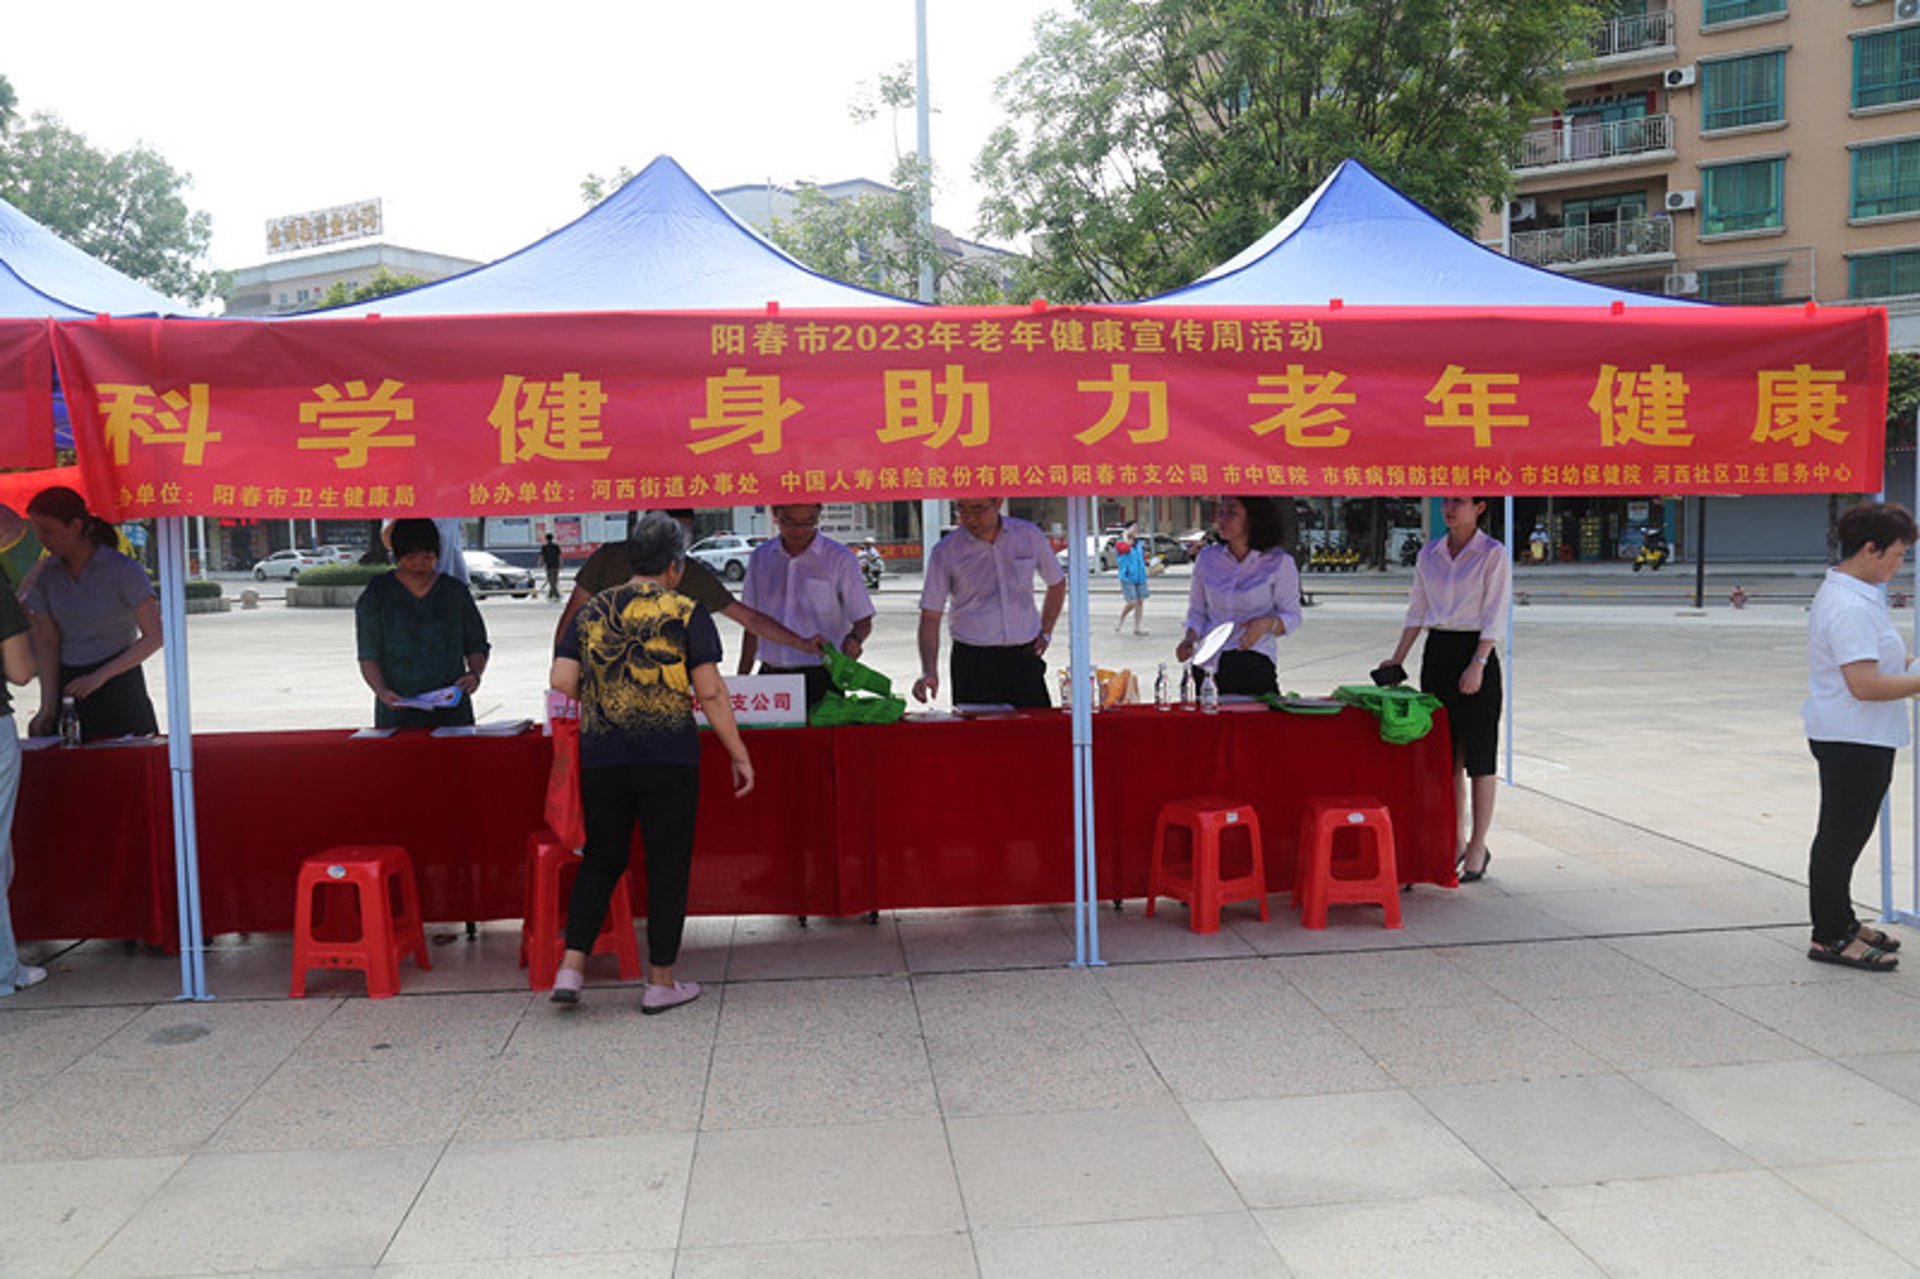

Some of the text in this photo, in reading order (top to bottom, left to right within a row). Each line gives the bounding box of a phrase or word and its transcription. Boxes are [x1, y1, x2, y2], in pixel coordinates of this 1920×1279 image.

[711, 319, 1324, 356] 阳春市2023年老年健康宣传周活动
[781, 463, 1208, 493] 中国人寿保险股份有限公司阳春市支公司
[1223, 464, 1309, 486] 市中医院
[1323, 464, 1514, 487] 市疾病预防控制中心
[1520, 463, 1643, 486] 市妇幼保健院
[1652, 462, 1853, 485] 河西社区卫生服务中心
